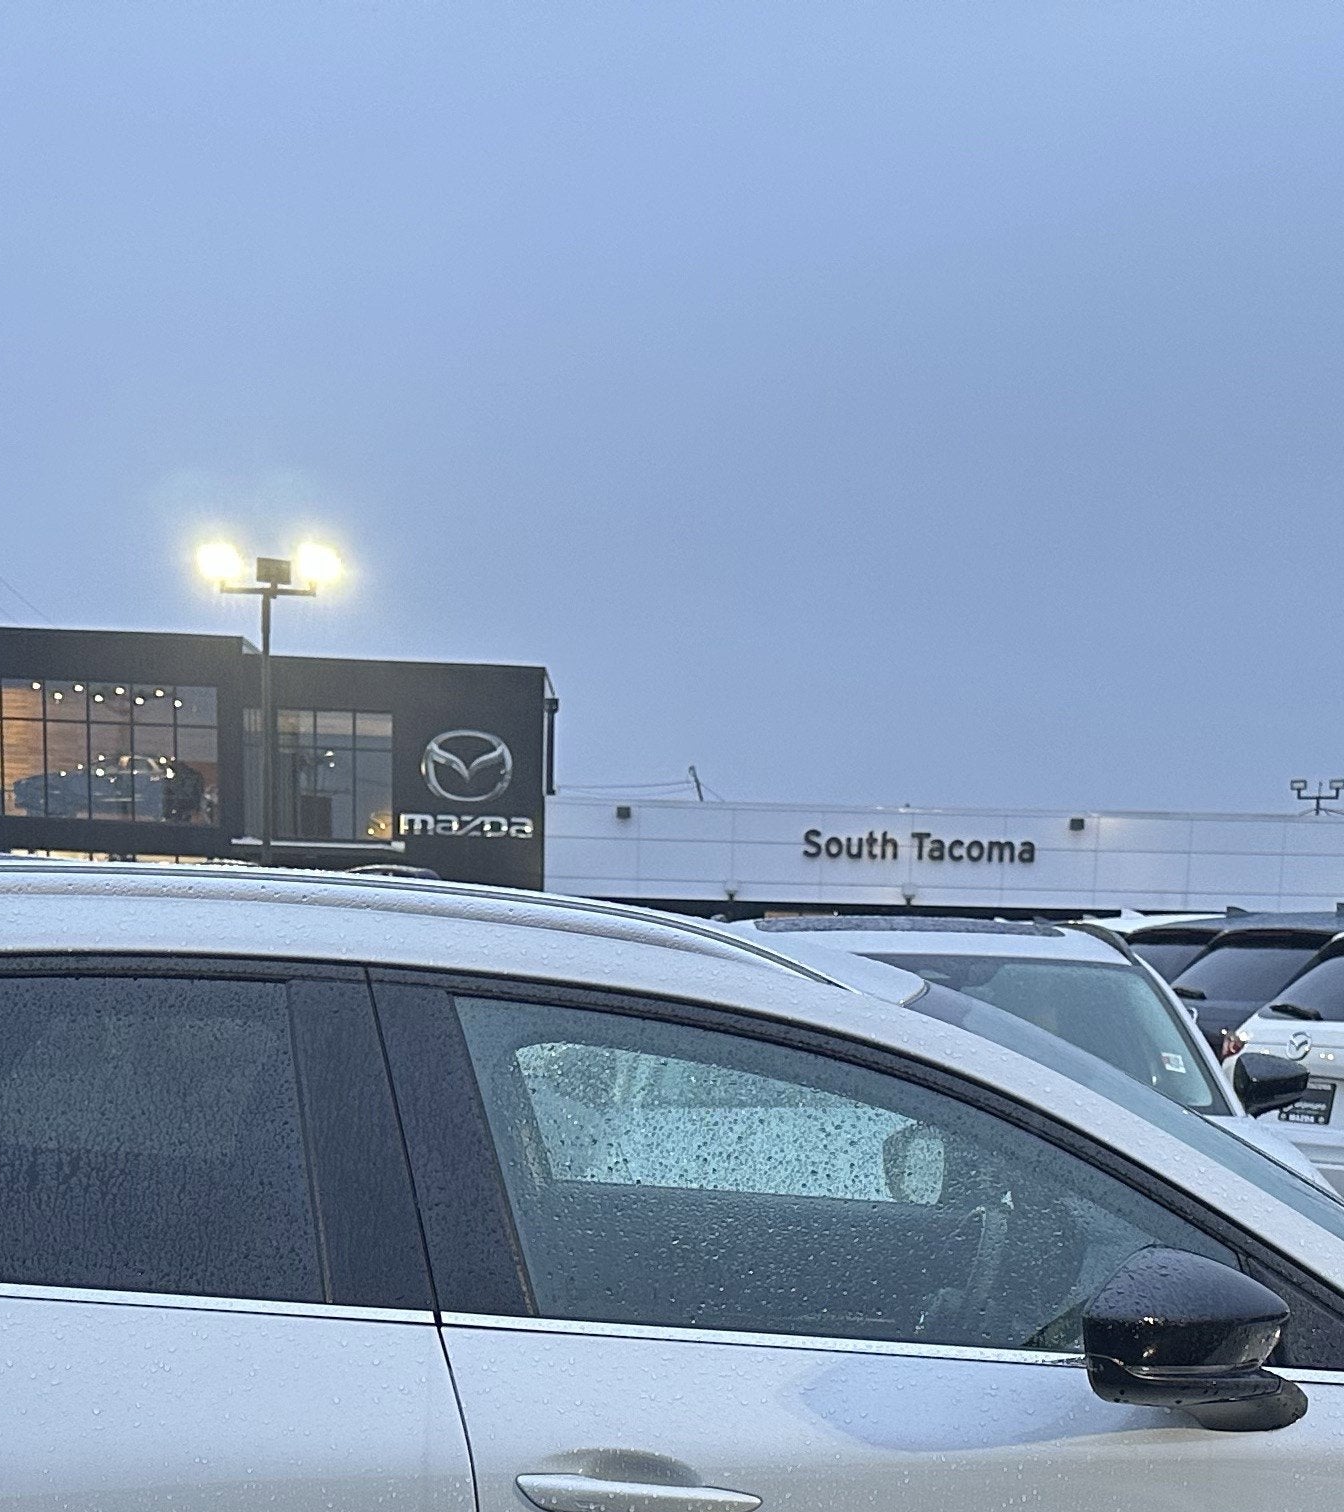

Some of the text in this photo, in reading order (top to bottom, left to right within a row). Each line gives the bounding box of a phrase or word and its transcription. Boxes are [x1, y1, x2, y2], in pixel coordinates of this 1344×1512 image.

[399, 813, 534, 838] mazda
[802, 829, 1036, 863] South Tacoma
